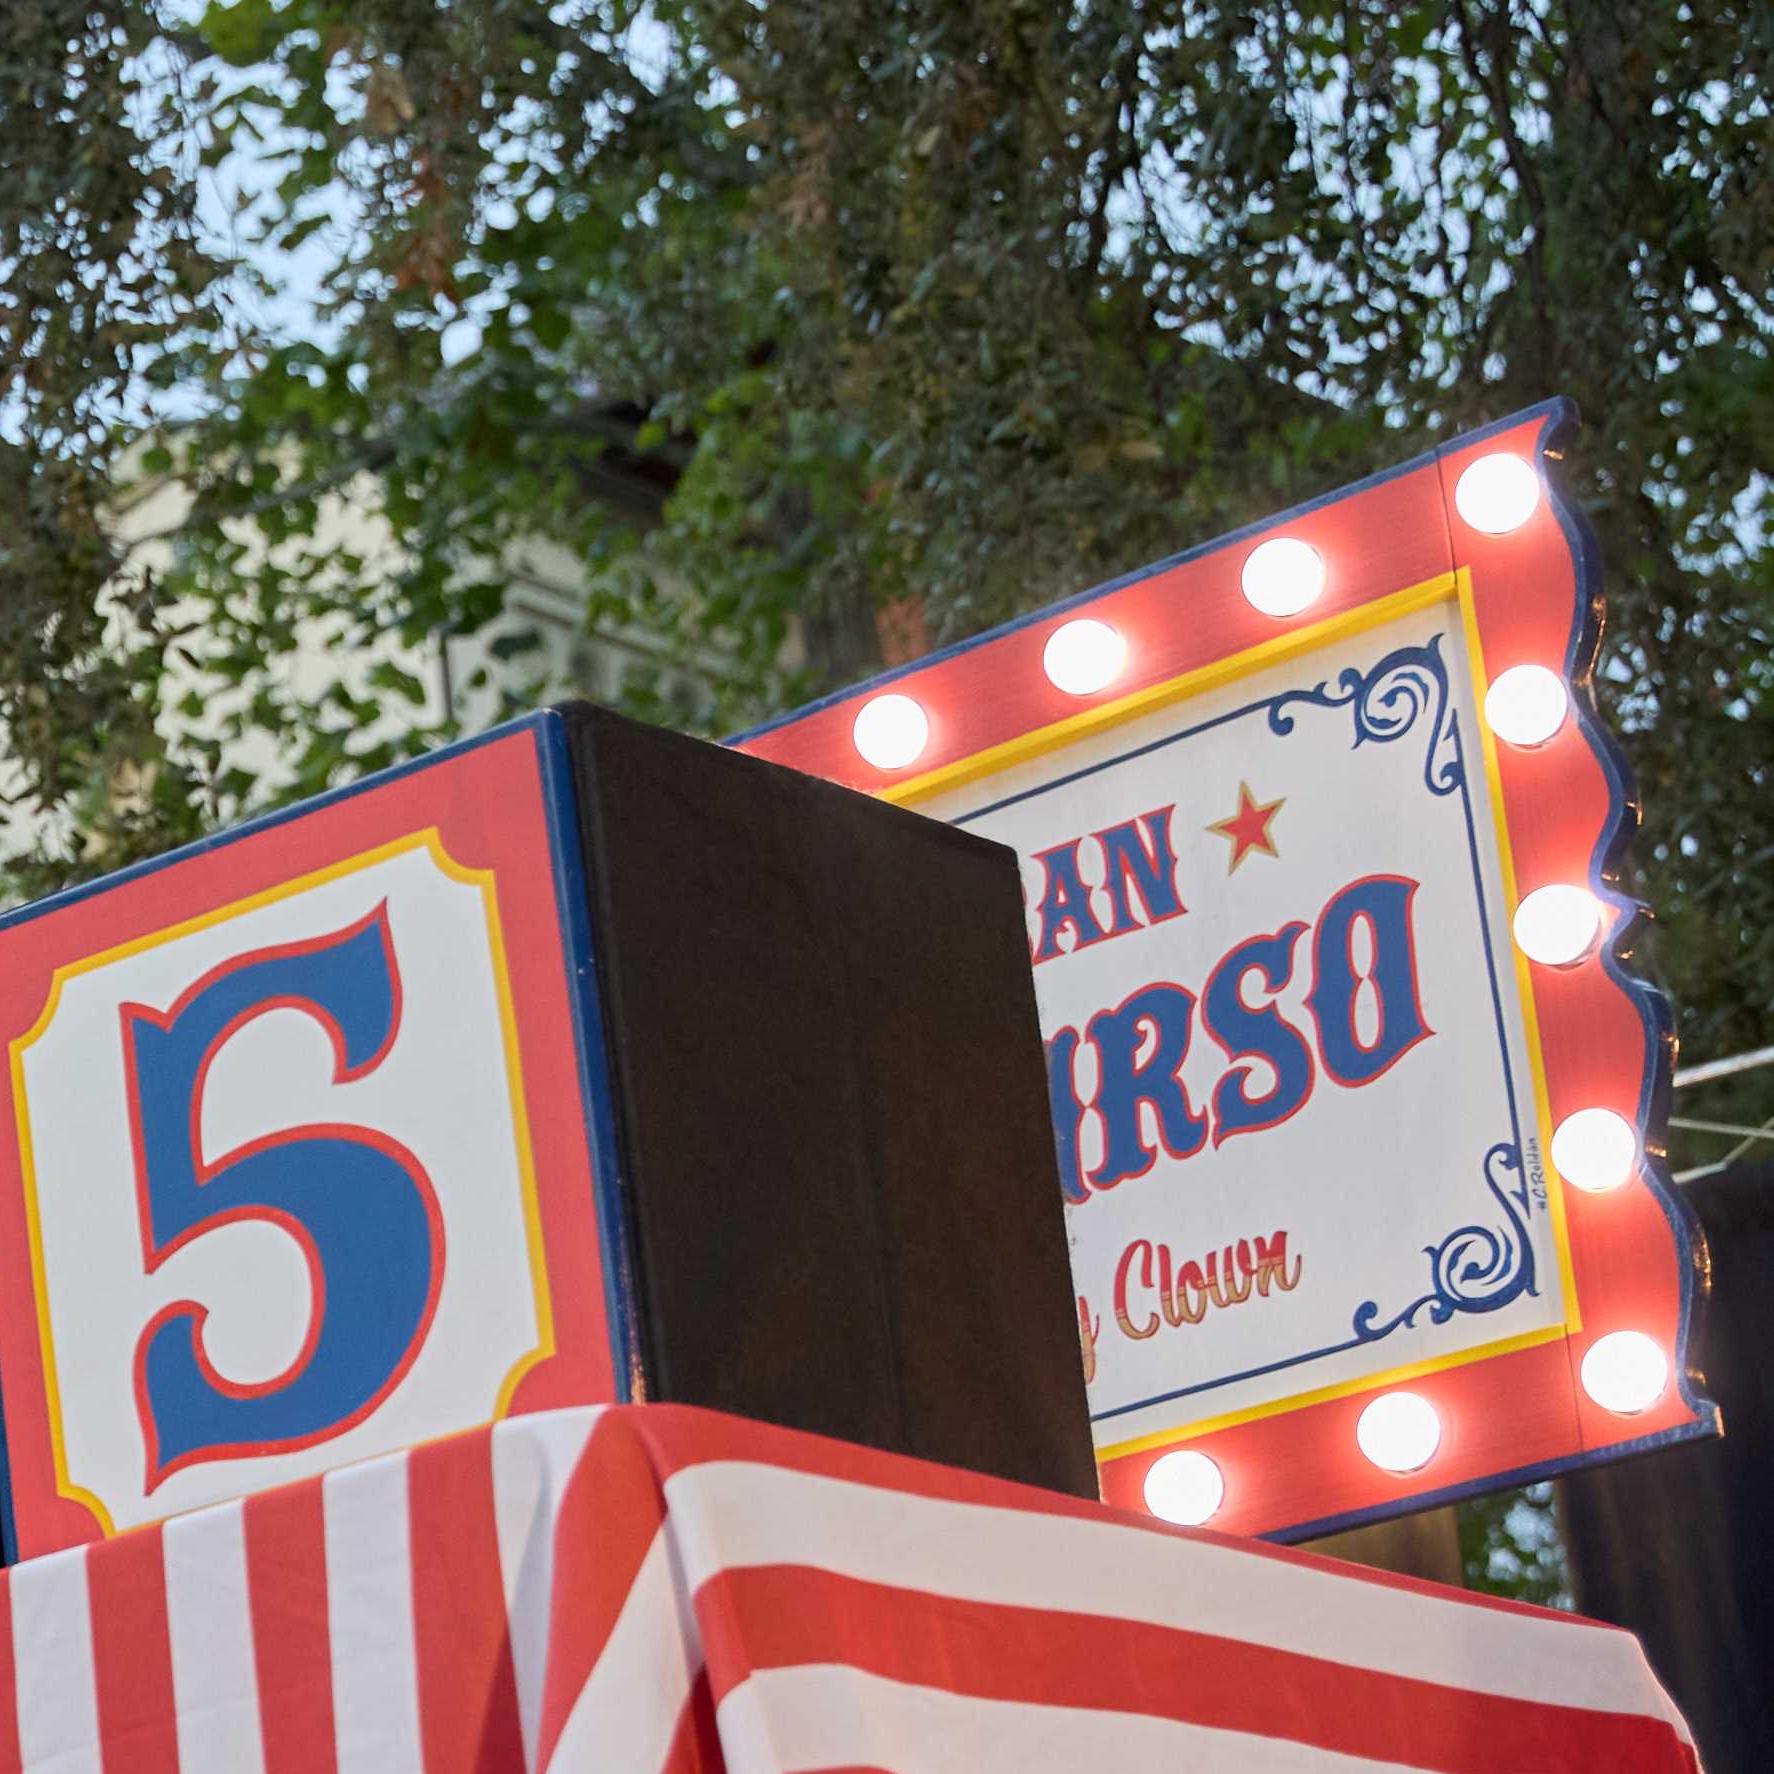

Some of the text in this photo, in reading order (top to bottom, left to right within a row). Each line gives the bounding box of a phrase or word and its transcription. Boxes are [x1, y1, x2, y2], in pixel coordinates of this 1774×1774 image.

[1023, 803, 1189, 967] AN
[119, 899, 446, 1496] 5
[1113, 1230, 1302, 1340] Clown
